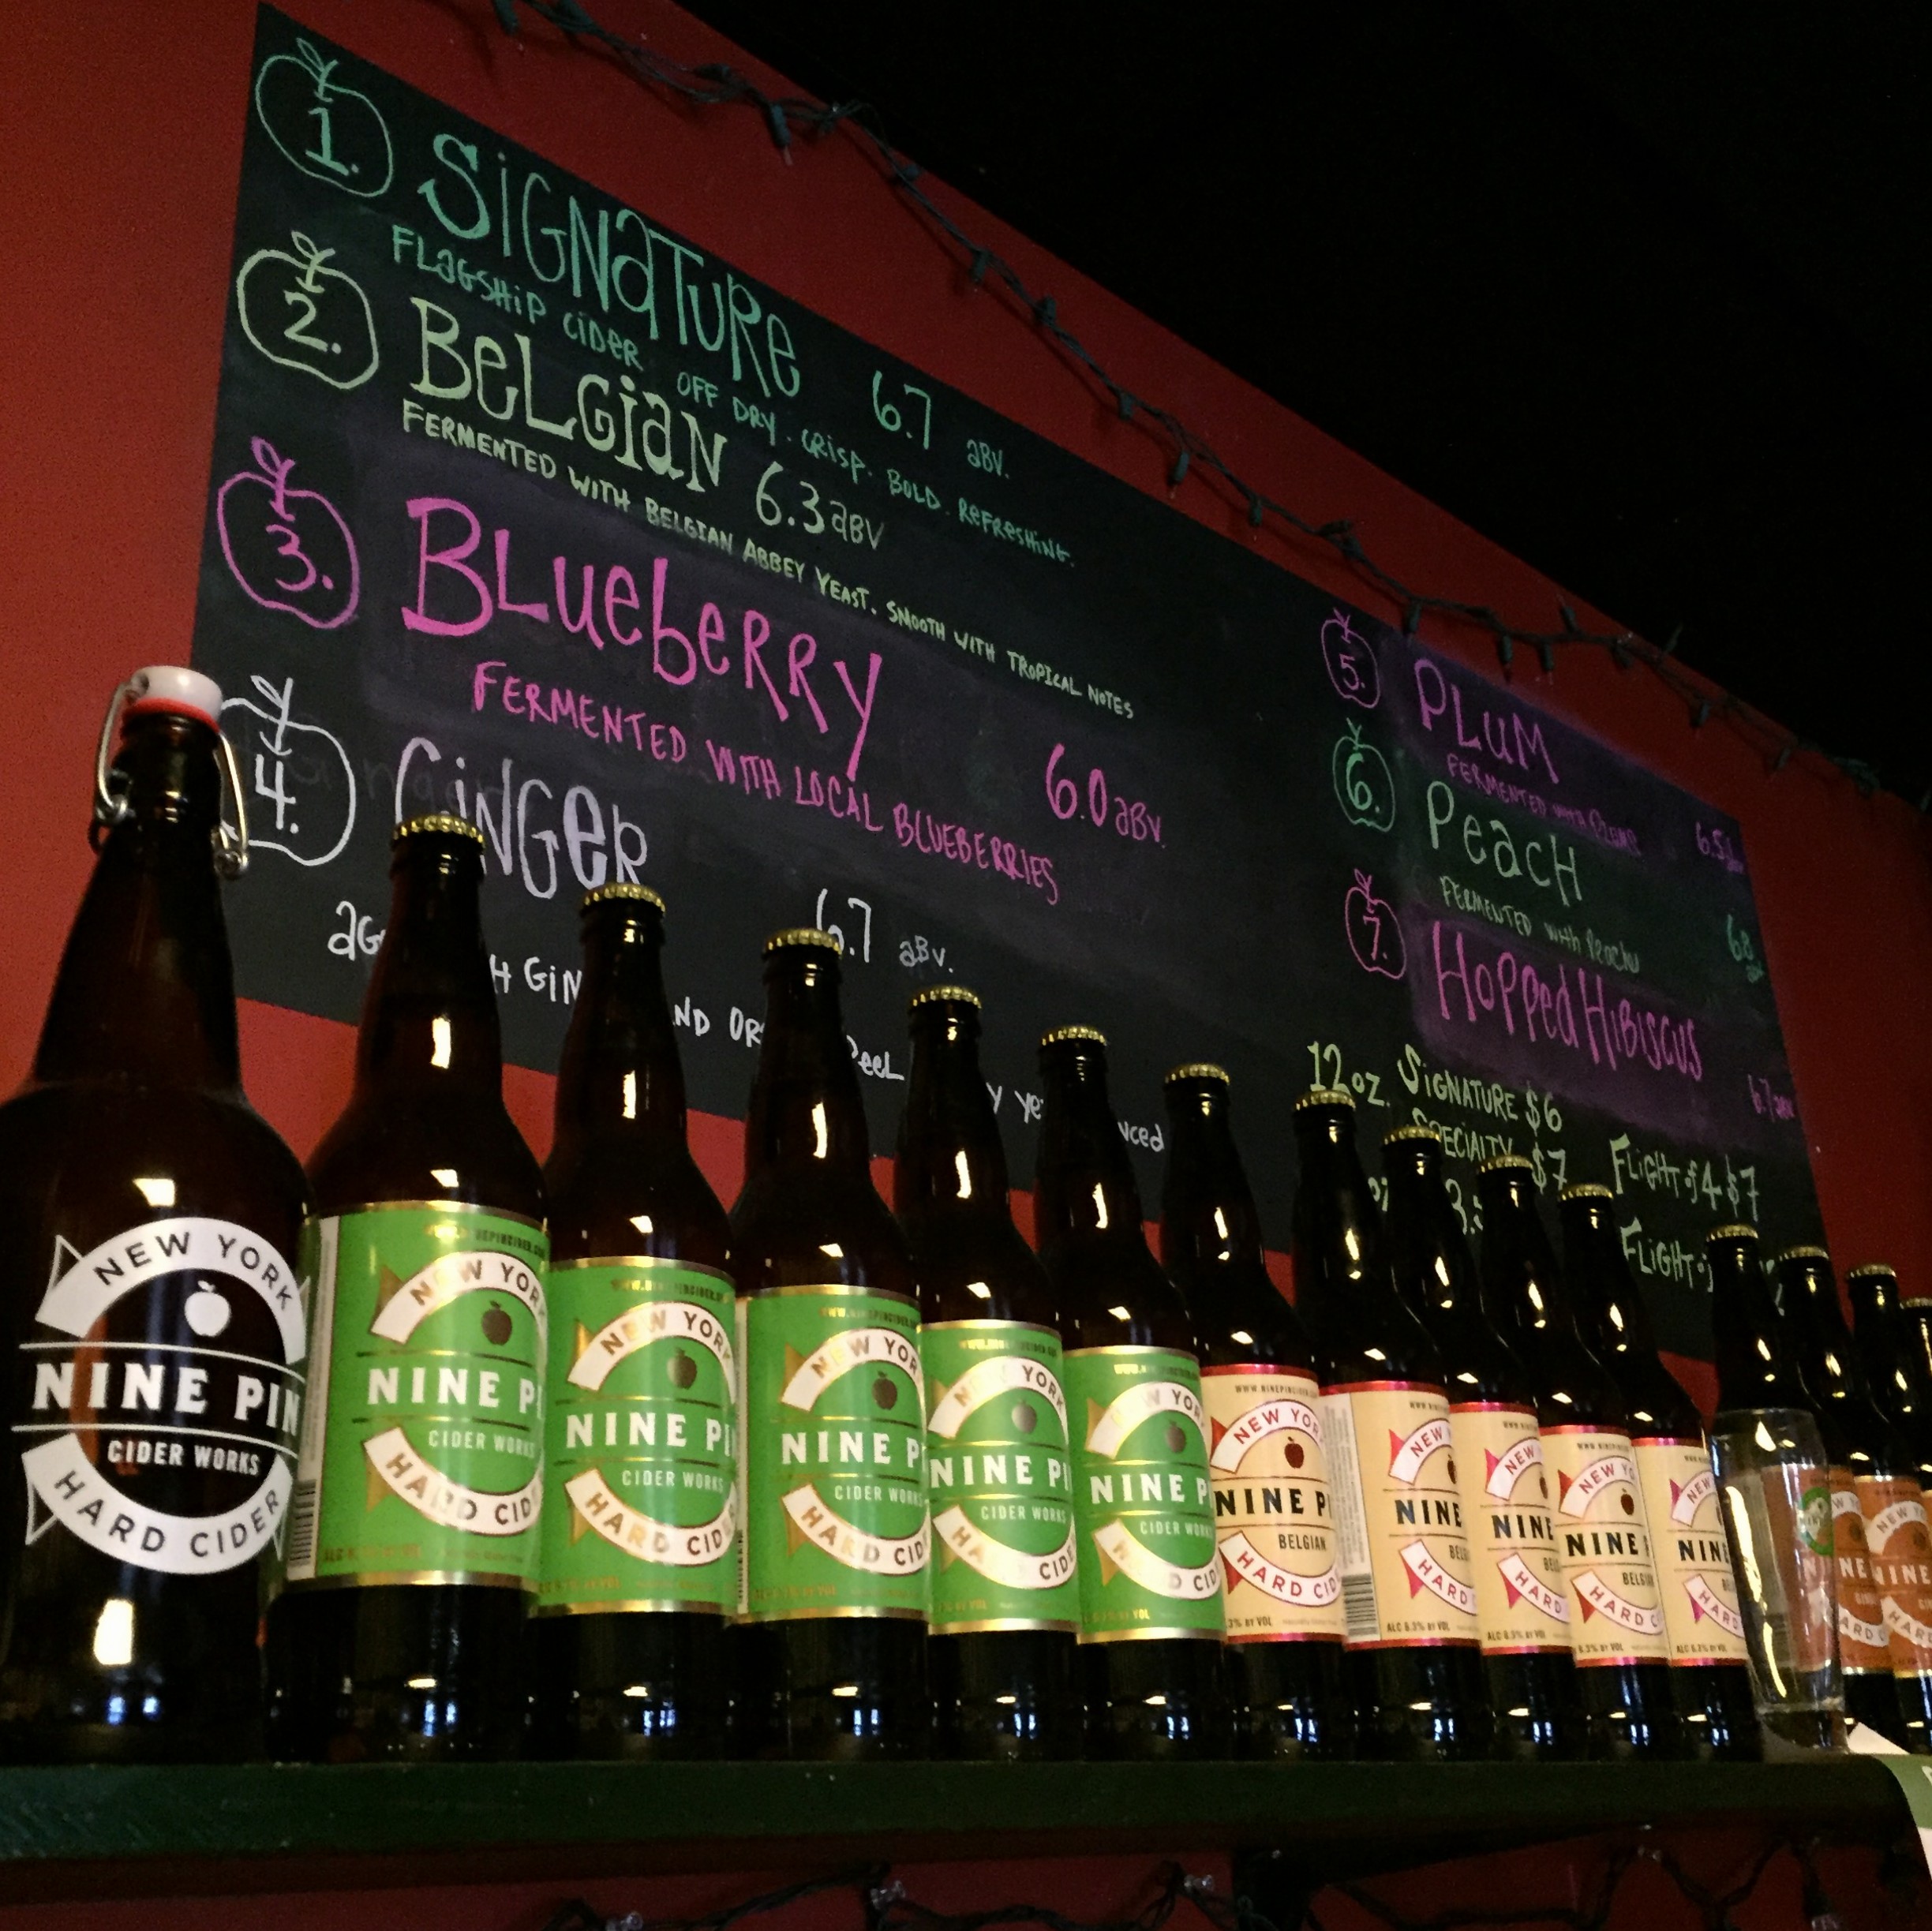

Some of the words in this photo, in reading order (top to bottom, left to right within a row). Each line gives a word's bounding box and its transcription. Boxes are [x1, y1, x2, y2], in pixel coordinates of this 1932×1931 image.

[283, 290, 342, 355] 2.
[677, 372, 719, 407] OFF
[872, 370, 931, 450] 6.7
[755, 461, 826, 534] 6.3
[265, 524, 335, 593] 3.
[402, 399, 556, 479] FERMENTED
[568, 466, 631, 513] WITH
[645, 497, 733, 556] BELGIAN
[743, 538, 805, 582] ABBEY
[814, 566, 878, 616] YEAST.
[886, 600, 946, 642] SMOOTH
[953, 631, 995, 663] WITH
[1007, 650, 1083, 698] TROPICAL
[1088, 683, 1134, 719] NOTES
[255, 753, 299, 835] 4.
[472, 661, 687, 764] FERMENTED
[705, 739, 782, 800] WITH
[794, 765, 883, 832] LOCAL
[893, 803, 1058, 905] BLUEBERRIES
[1046, 743, 1107, 826] 6.0
[1345, 752, 1381, 814] 6.
[1363, 915, 1390, 961] 7.
[672, 997, 710, 1037] ND
[1525, 1080, 1563, 1137] $6
[1531, 1141, 1567, 1195] $7
[1702, 1160, 1723, 1211] 4
[94, 1232, 190, 1286] NEW
[218, 1233, 293, 1311] YORK
[884, 1336, 918, 1375] YOR
[31, 1362, 213, 1415] NINE
[234, 1375, 301, 1436] PIN
[367, 1367, 500, 1408] NINE
[1172, 1389, 1200, 1420] YOR
[428, 1430, 487, 1450] CIDER
[493, 1435, 536, 1459] WORKS
[566, 1412, 687, 1449] NINE
[1234, 1409, 1279, 1444] NEW
[1291, 1409, 1319, 1436] YOR
[1410, 1427, 1443, 1458] NEW
[107, 1439, 184, 1468] CIDER
[193, 1445, 260, 1477] WORKS
[782, 1431, 891, 1466] NINE
[1505, 1445, 1534, 1475] NEW
[622, 1470, 675, 1488] CIDER
[683, 1472, 724, 1493] WORKS
[930, 1455, 1033, 1488] NINE
[1090, 1474, 1185, 1505] NINE
[1578, 1463, 1614, 1494] NEW
[1687, 1477, 1711, 1504] NEW
[834, 1485, 882, 1502] CIDER
[1215, 1488, 1304, 1517] NINE
[55, 1471, 166, 1553] HARD
[190, 1489, 278, 1558] CIDER
[586, 1492, 670, 1555] HARD
[980, 1506, 1025, 1521] CIDER
[1032, 1506, 1066, 1525] WORKS
[1140, 1521, 1181, 1536] CIDER
[1395, 1499, 1462, 1527] NINE
[1492, 1514, 1553, 1540] NINE
[1876, 1506, 1908, 1534] NEW
[1279, 1533, 1327, 1551] BELGIAN
[1565, 1532, 1639, 1557] NINE
[1237, 1551, 1302, 1597] HARD
[1418, 1559, 1468, 1604] HARD
[1515, 1570, 1562, 1614] HARD
[1256, 1616, 1272, 1627] VOL
[1589, 1586, 1644, 1626] HARD
